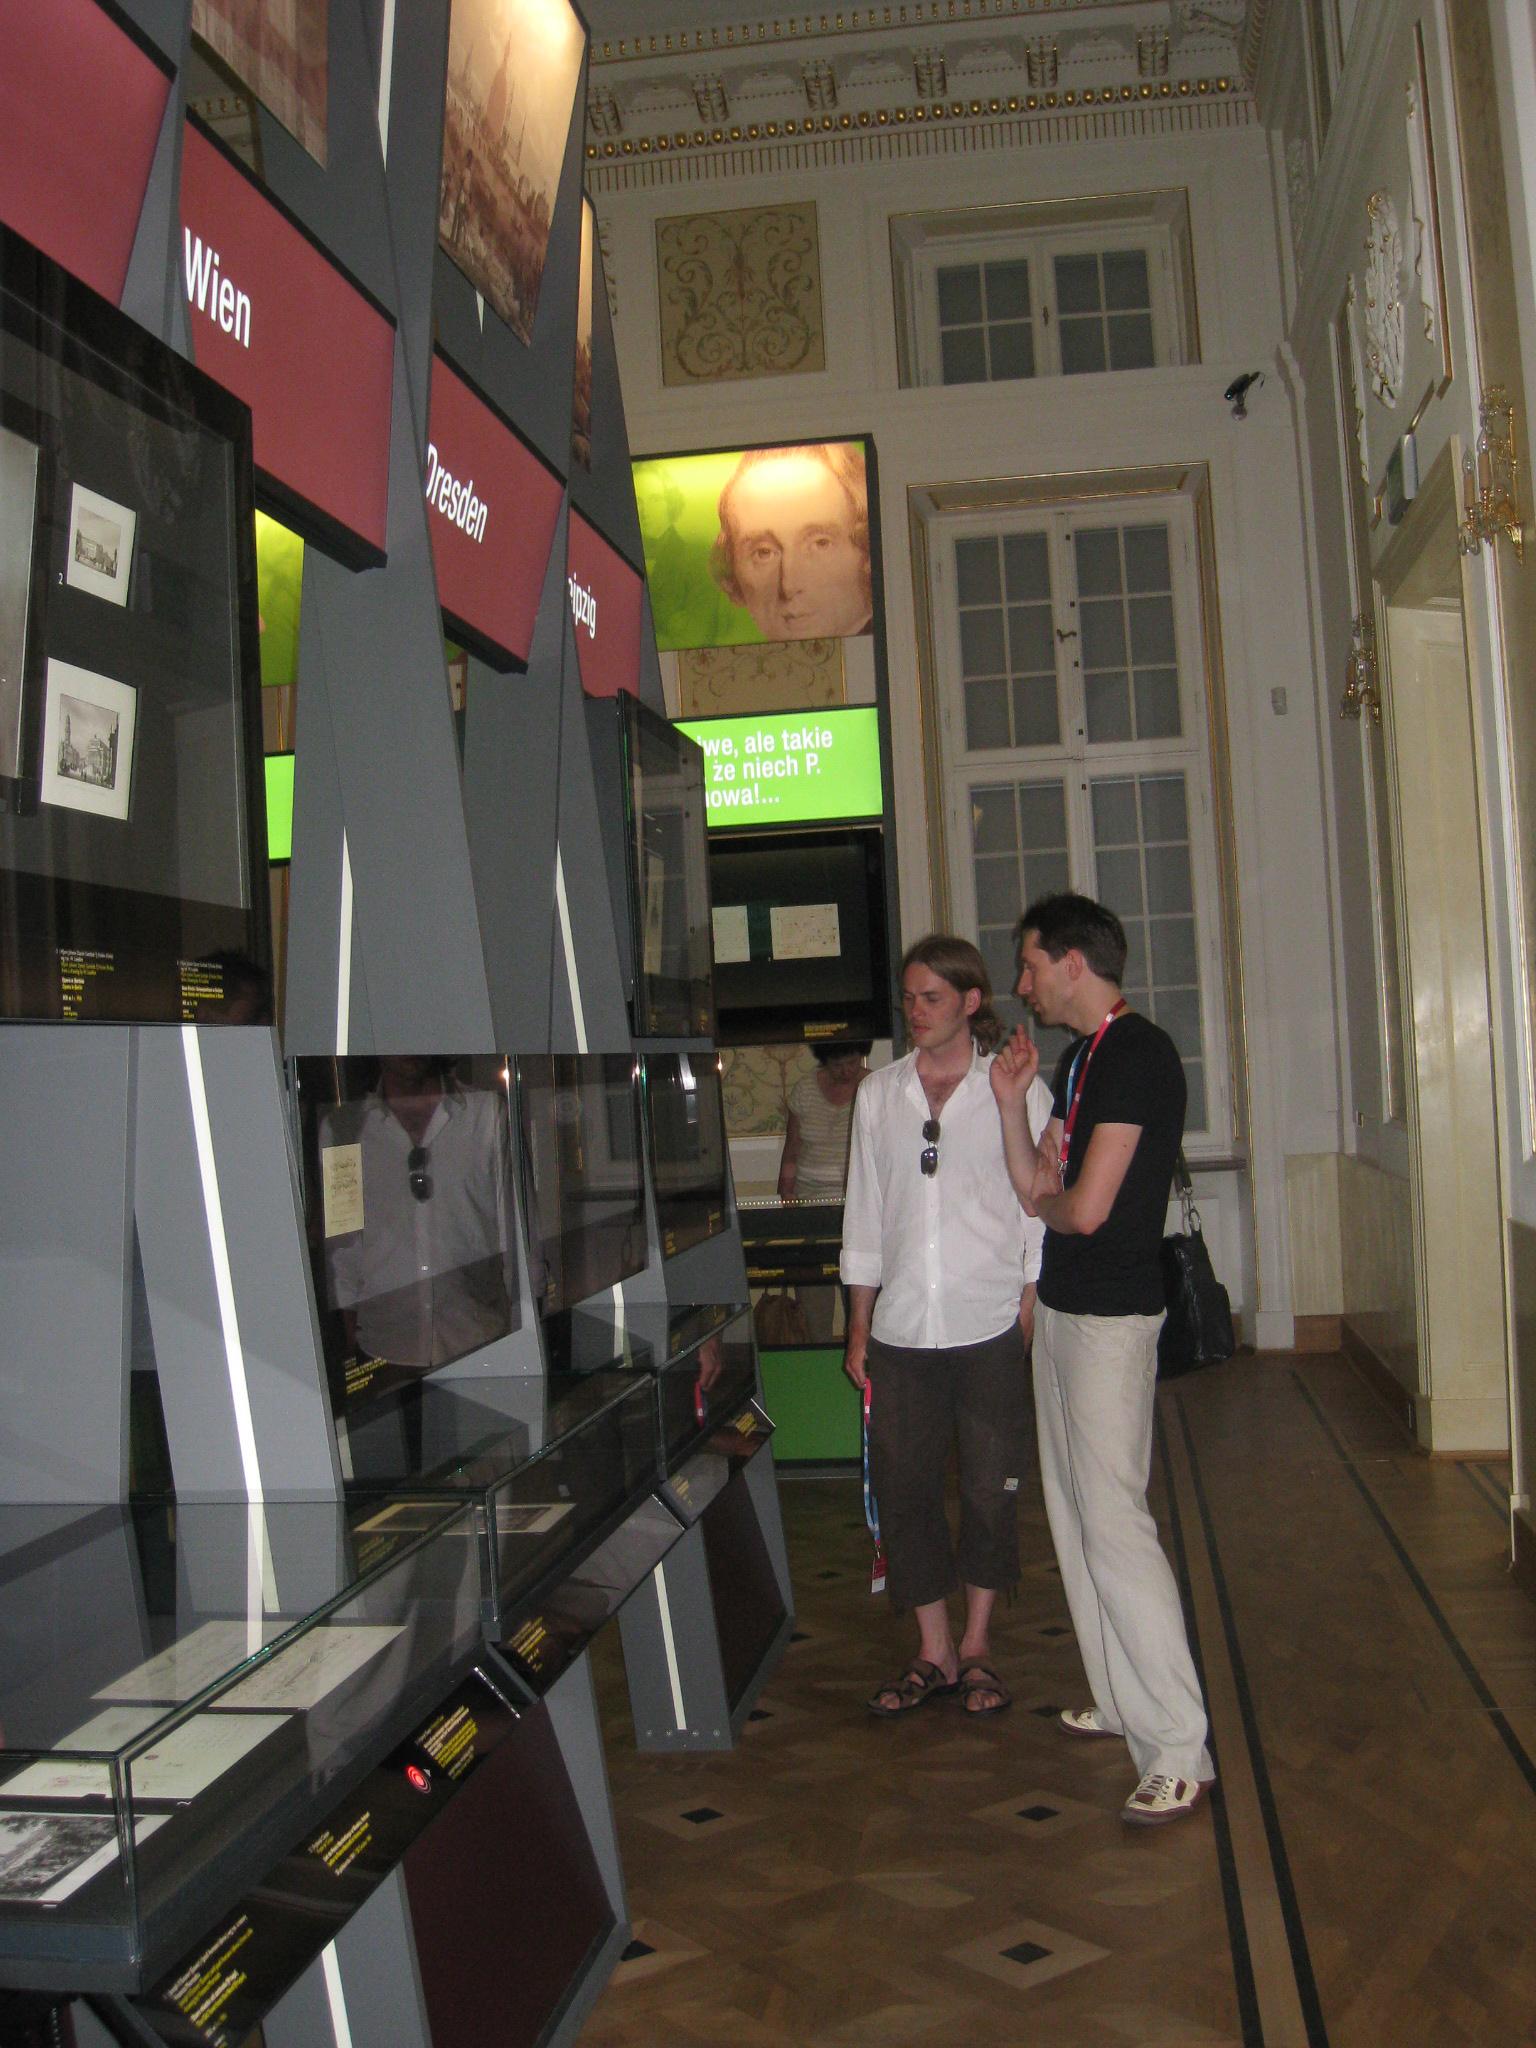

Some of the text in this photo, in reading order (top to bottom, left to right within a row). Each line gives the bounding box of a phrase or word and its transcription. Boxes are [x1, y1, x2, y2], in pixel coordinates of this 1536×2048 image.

[185, 226, 251, 349] Wien
[745, 730, 775, 754] ale
[782, 726, 833, 751] takie
[713, 752, 821, 782] że niech P.
